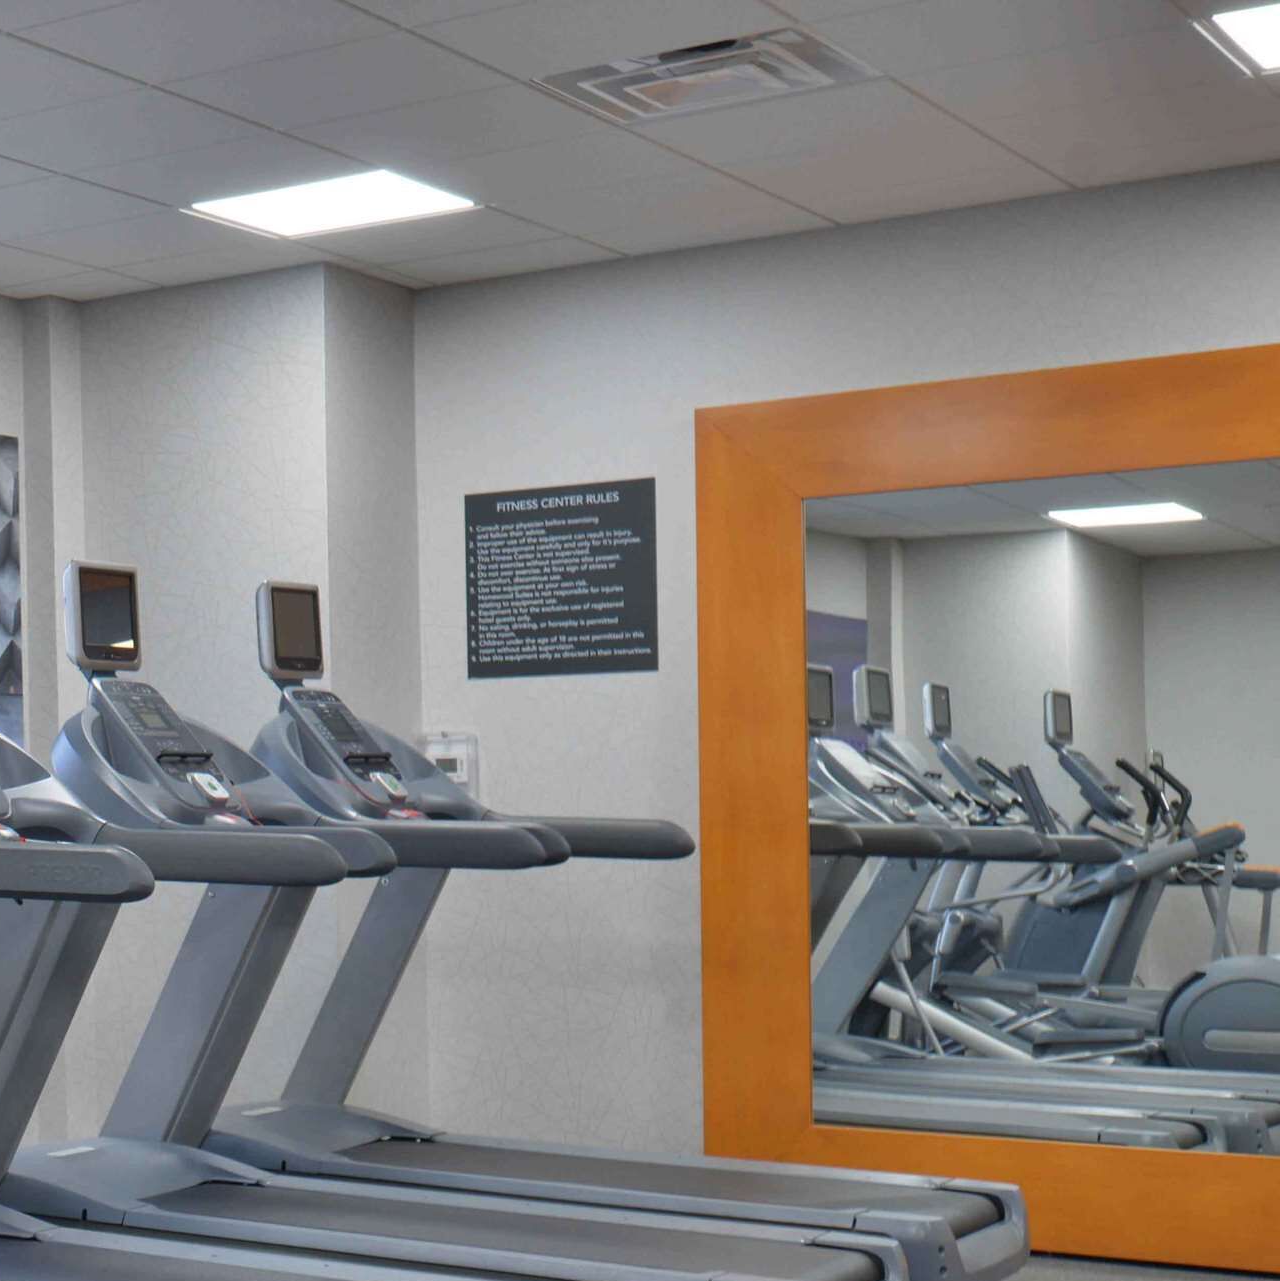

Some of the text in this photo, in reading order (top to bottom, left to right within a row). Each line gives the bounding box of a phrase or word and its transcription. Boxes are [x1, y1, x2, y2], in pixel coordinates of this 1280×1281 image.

[497, 491, 619, 512] FITNESS CENTER RULES
